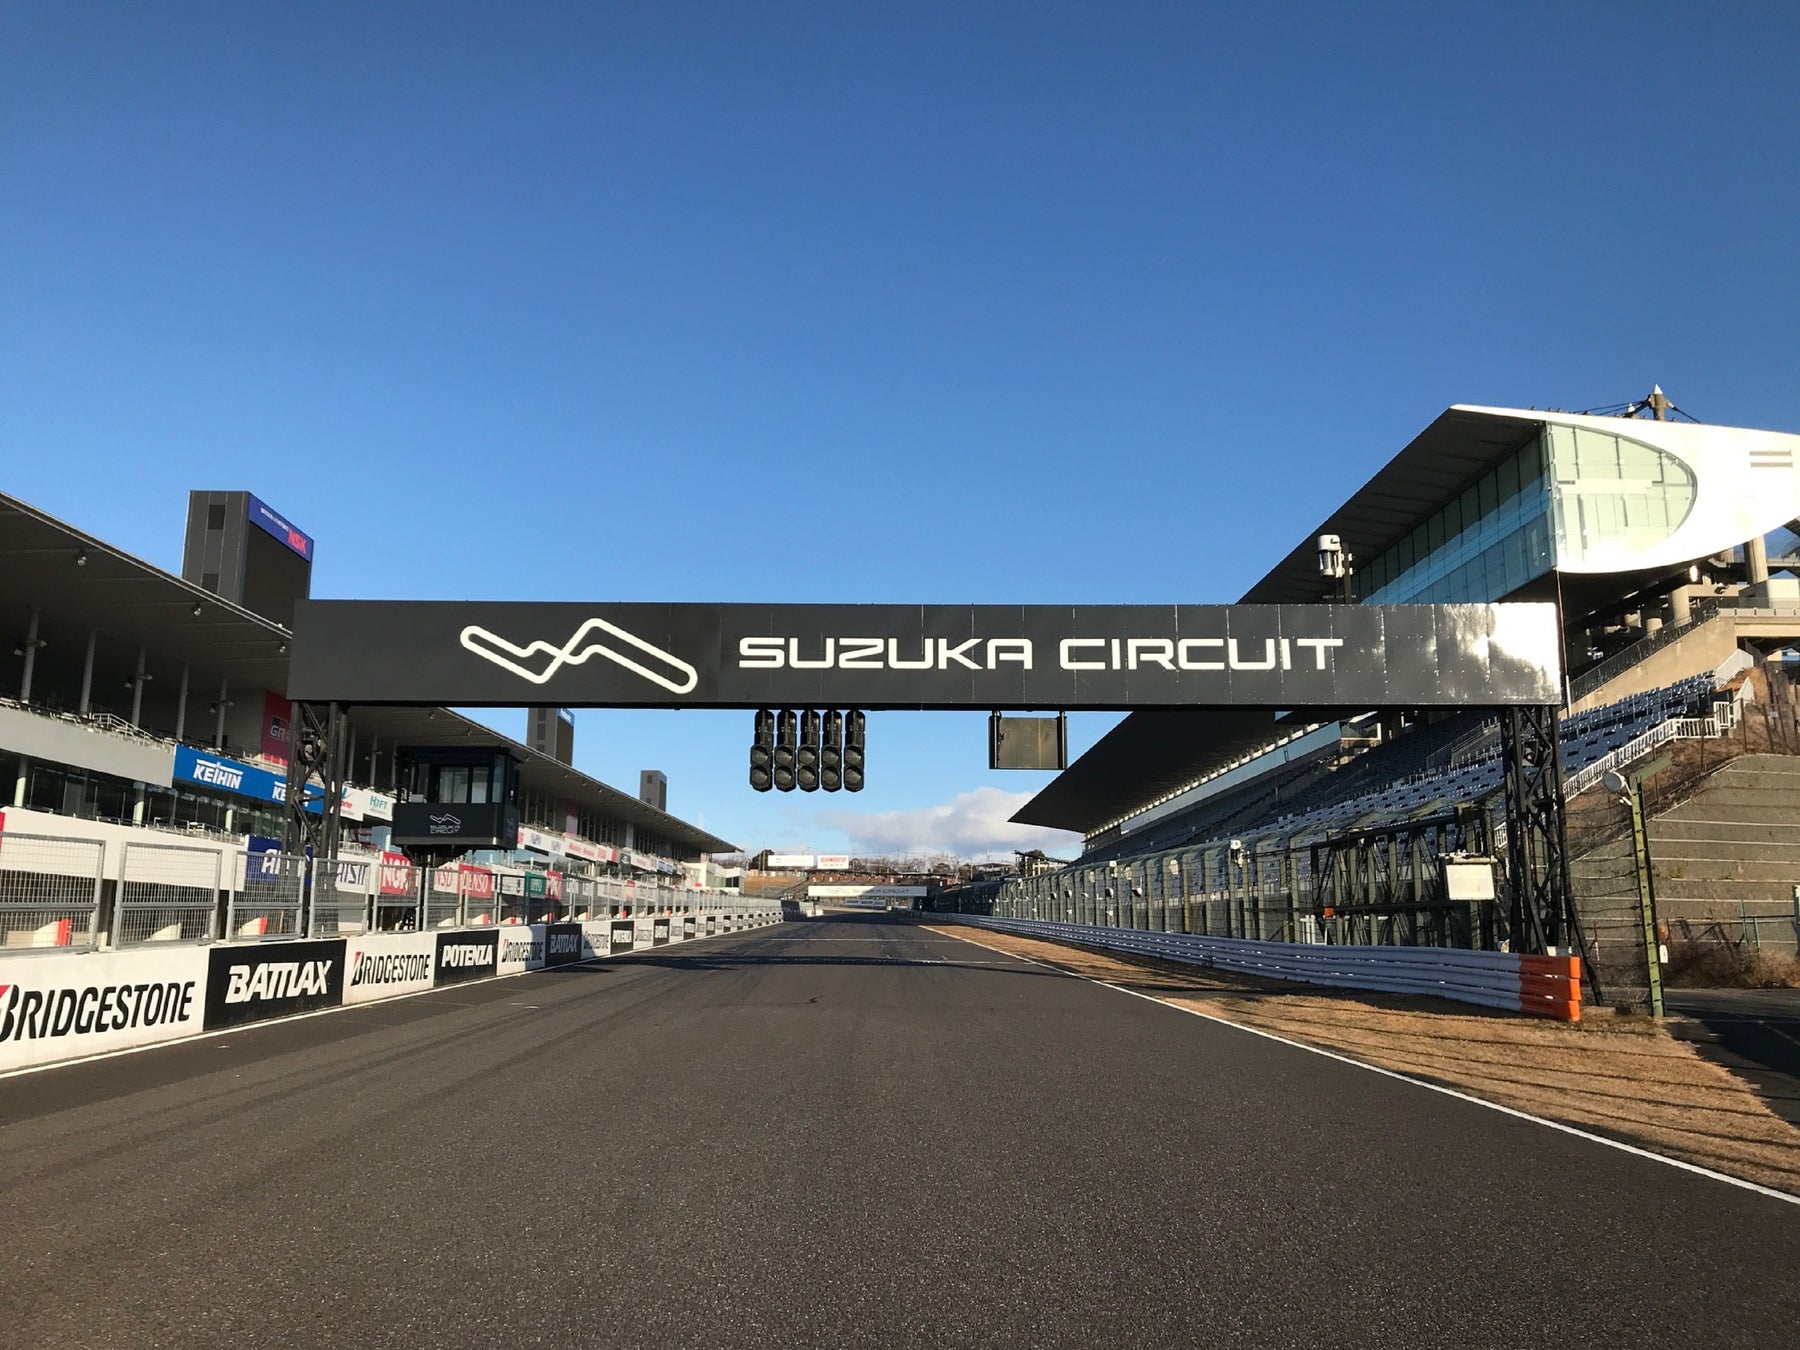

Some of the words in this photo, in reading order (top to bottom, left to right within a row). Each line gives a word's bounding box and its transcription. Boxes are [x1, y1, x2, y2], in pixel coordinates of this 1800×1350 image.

[288, 528, 307, 554] NSK
[738, 637, 1033, 670] SUZUKA
[1059, 637, 1344, 670] CIRCUIT
[193, 759, 244, 790] KEIHIN
[441, 944, 493, 968] POTENZA
[501, 938, 544, 963] BRIDGESTONE
[225, 960, 333, 1004] BATTLAX
[351, 951, 431, 987] BRIDGESTONE
